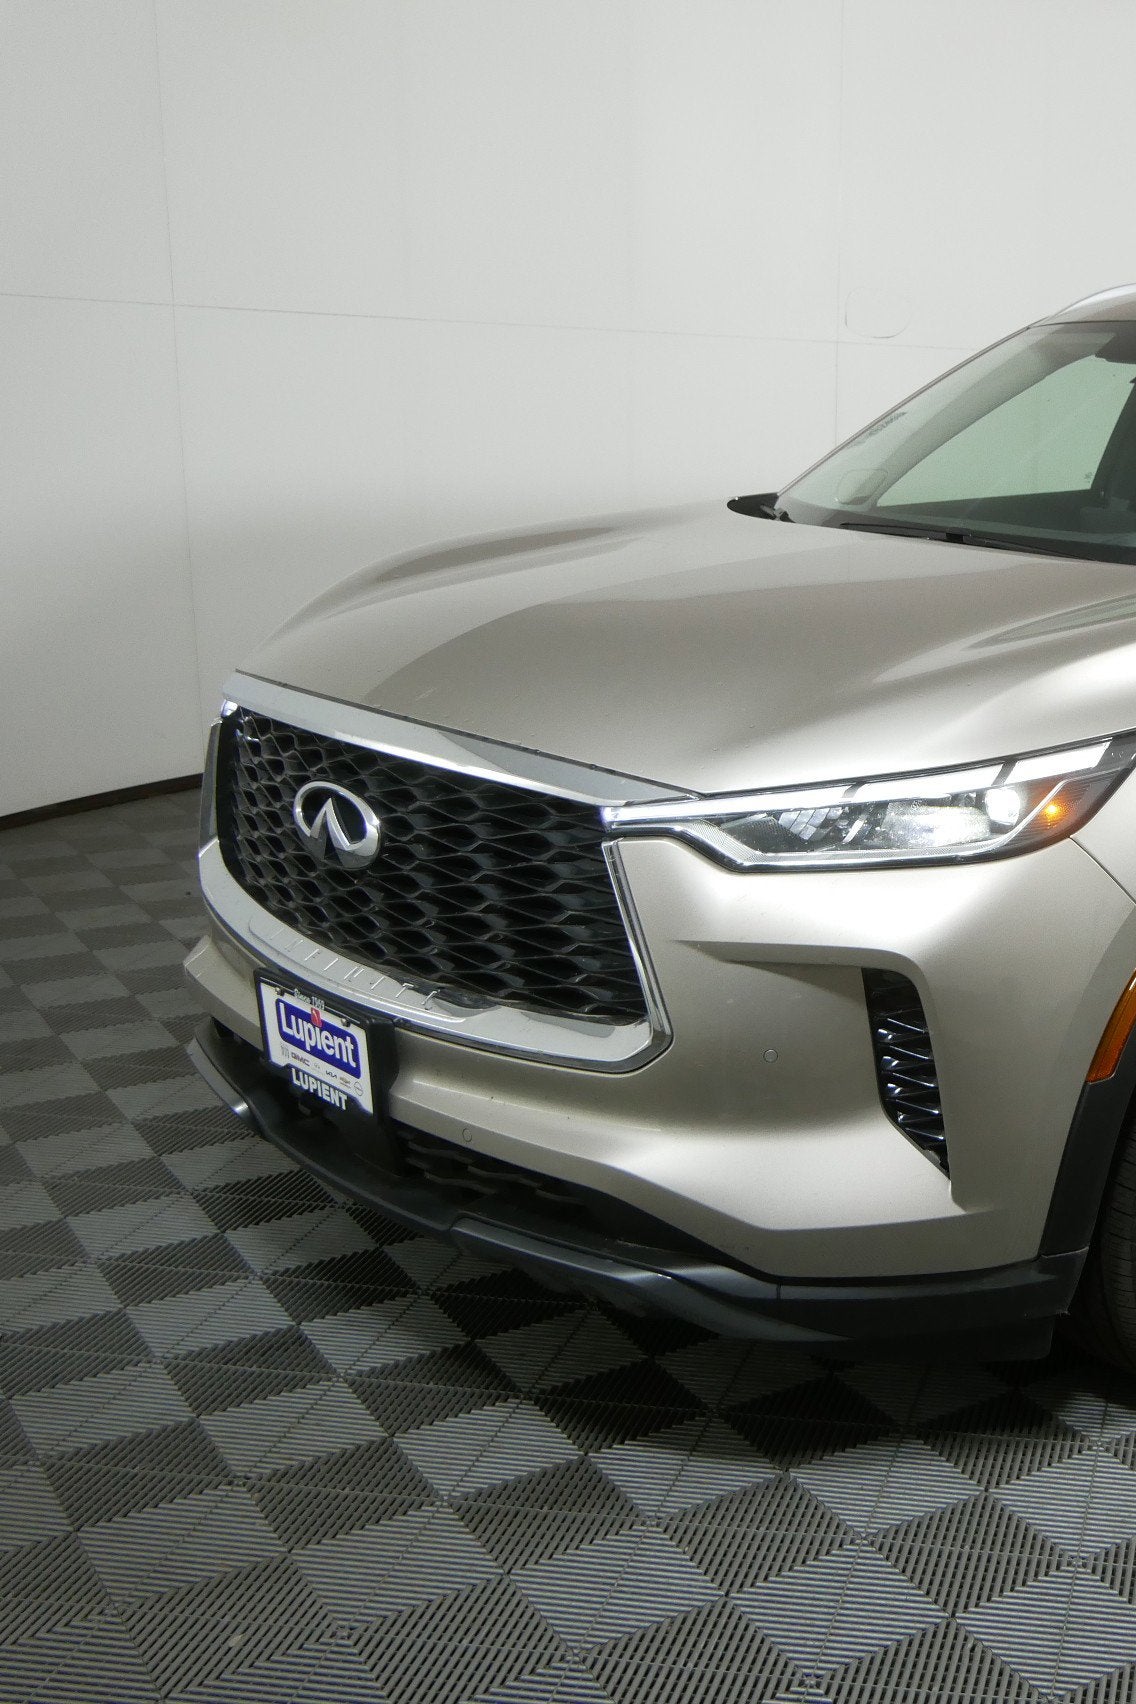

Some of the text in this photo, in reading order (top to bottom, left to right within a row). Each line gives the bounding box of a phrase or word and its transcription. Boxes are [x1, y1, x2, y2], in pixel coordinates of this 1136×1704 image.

[280, 1002, 357, 1067] Lupient
[291, 1052, 310, 1066] GMC
[291, 1068, 347, 1110] LUPIENT
